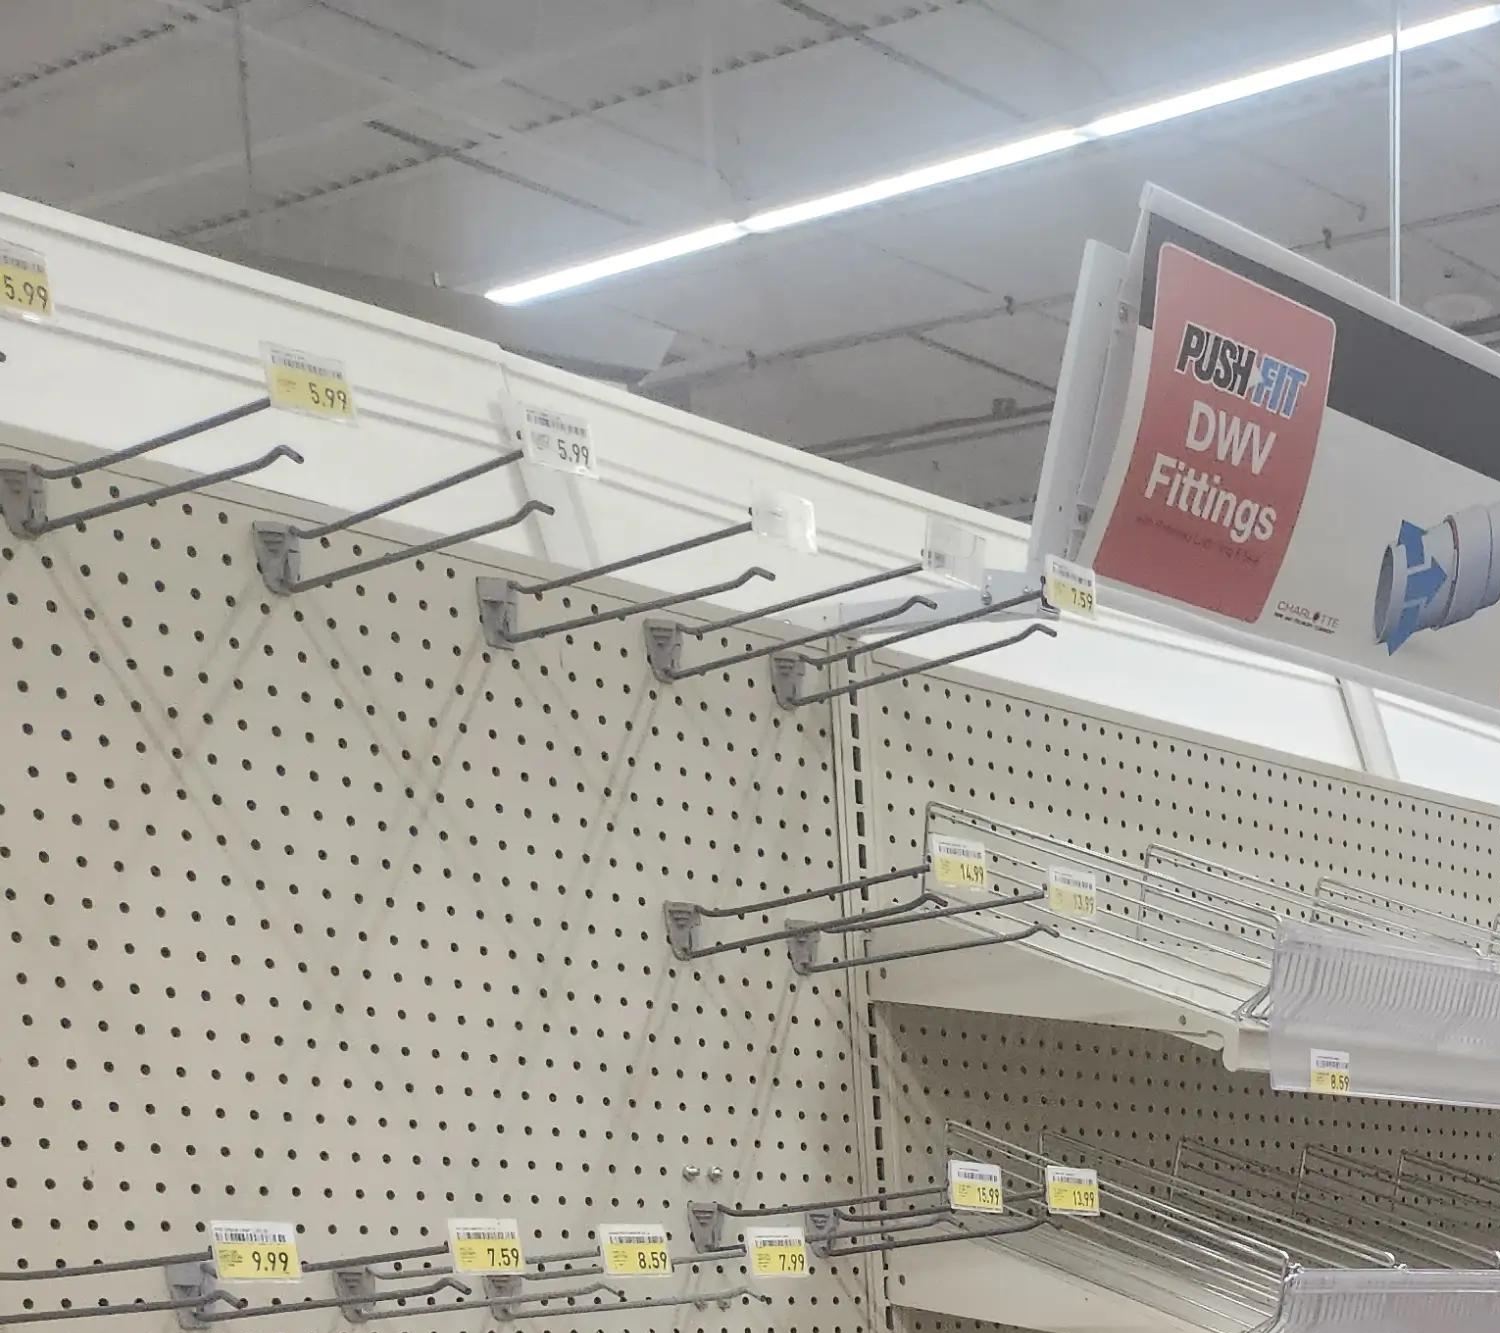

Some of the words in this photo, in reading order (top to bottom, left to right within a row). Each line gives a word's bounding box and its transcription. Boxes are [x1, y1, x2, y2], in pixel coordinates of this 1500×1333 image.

[2, 276, 49, 312] 5.99
[308, 381, 348, 410] 5.99
[1186, 400, 1277, 475] DWV
[558, 439, 590, 465] 5.99
[1144, 453, 1277, 543] Fittings
[1071, 587, 1093, 608] 7.59
[960, 863, 984, 885] 14.99
[977, 1186, 1000, 1205] 15.99
[252, 1251, 289, 1272] 9.99
[487, 1247, 519, 1268] 7.59
[638, 1251, 668, 1271] 8.59
[779, 1254, 805, 1272] 7.99
